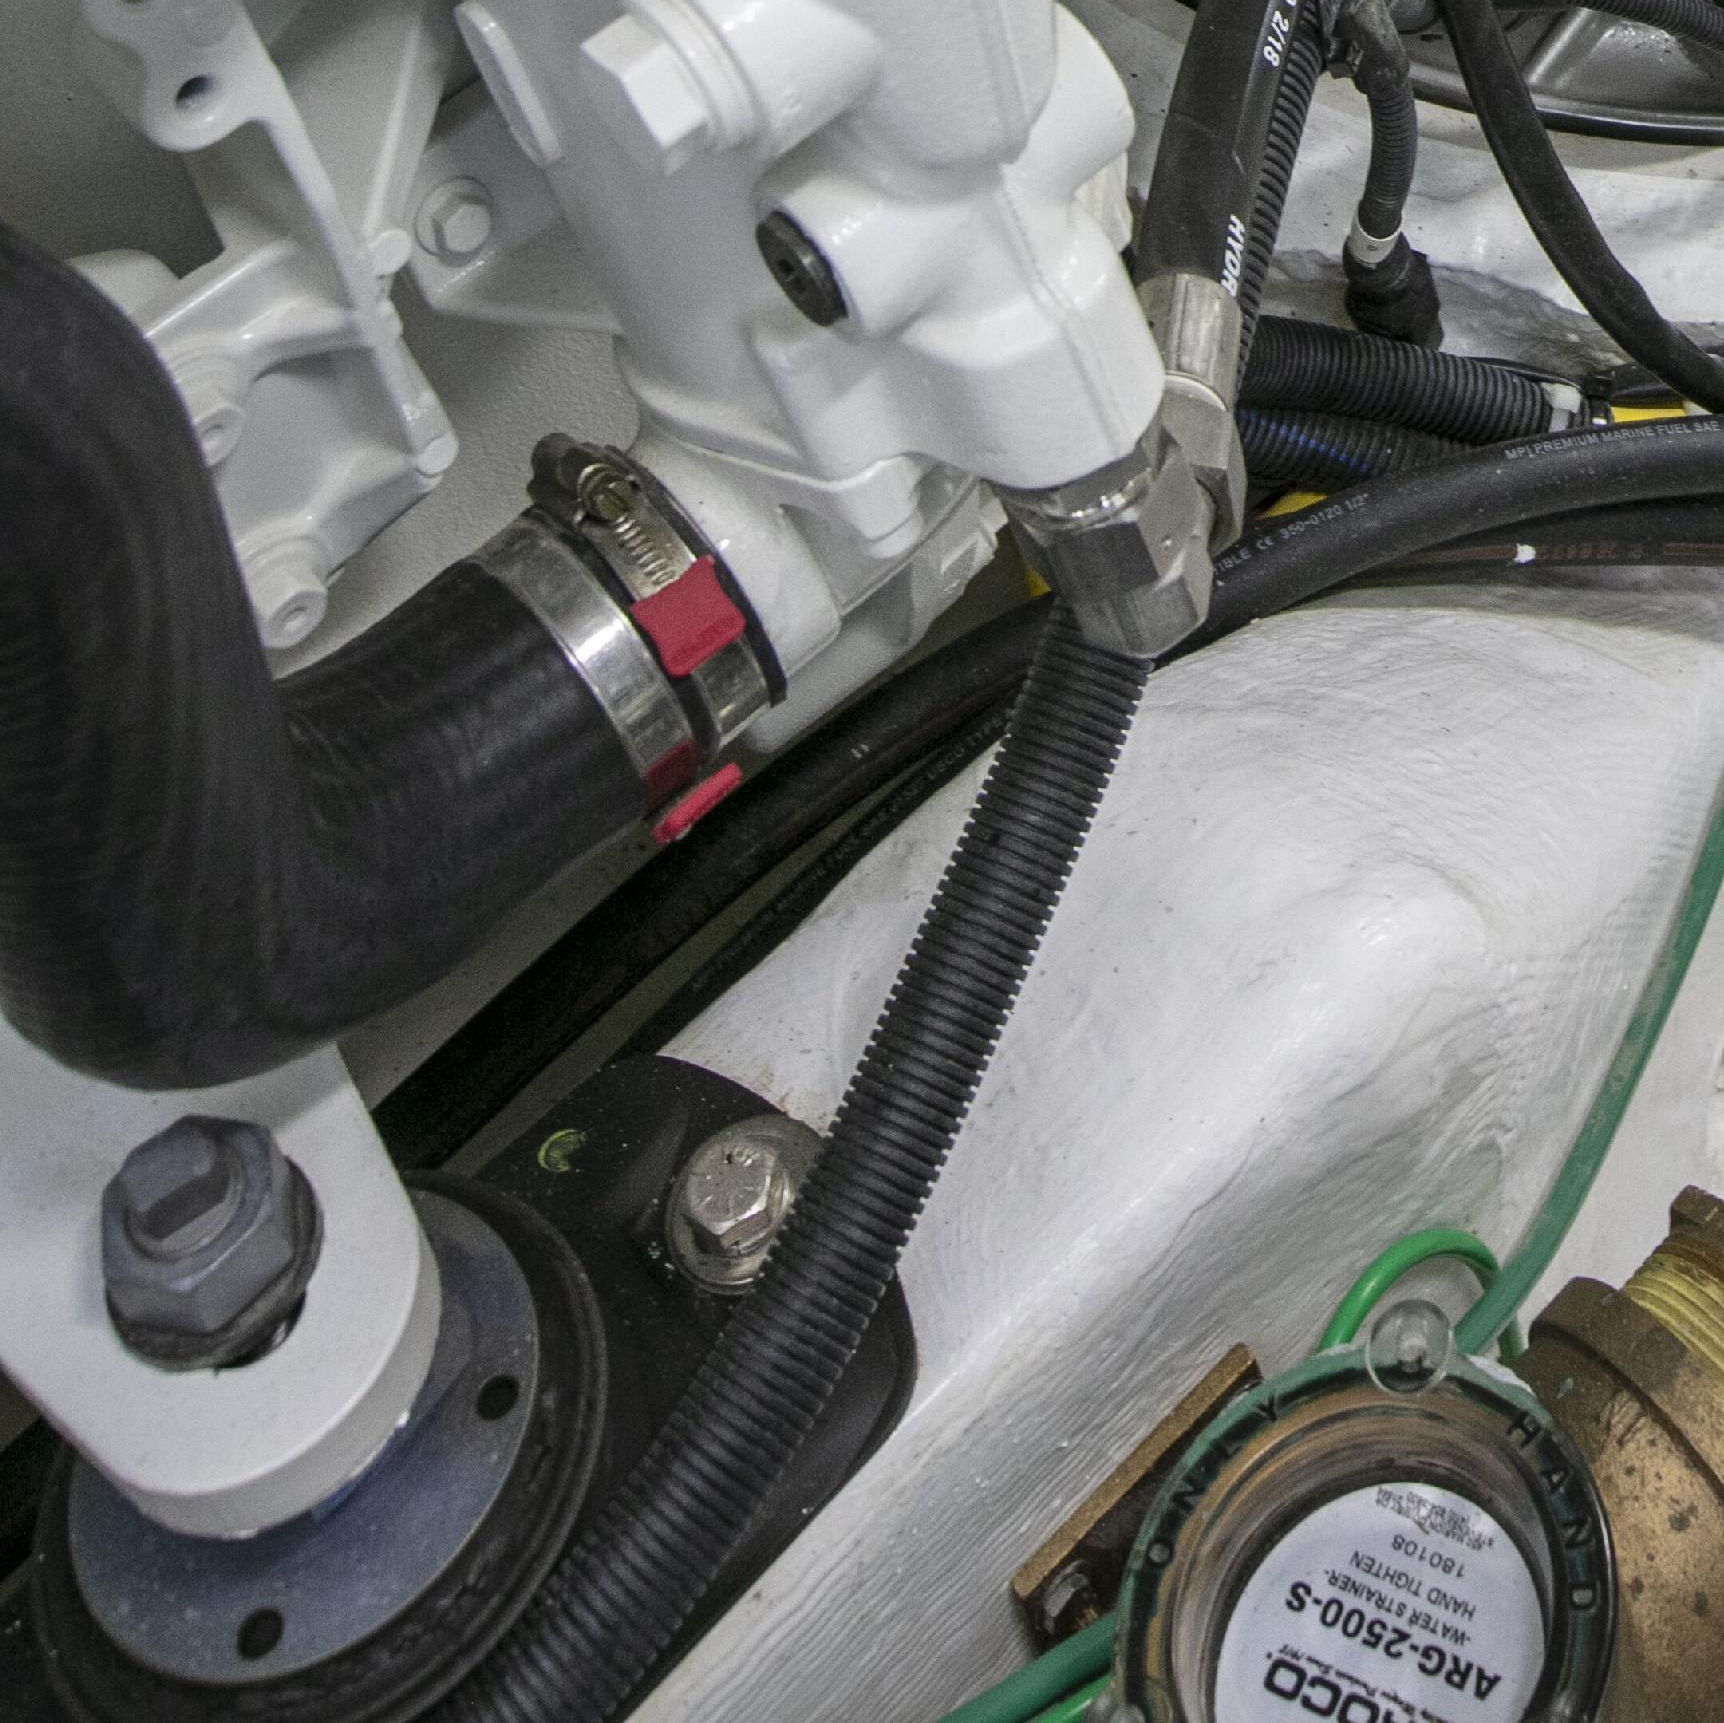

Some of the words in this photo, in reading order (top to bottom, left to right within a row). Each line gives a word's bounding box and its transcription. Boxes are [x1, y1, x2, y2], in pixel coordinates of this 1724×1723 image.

[1263, 10, 1289, 67] 2/18
[1534, 432, 1600, 458] PREMIUM
[1600, 425, 1653, 443] MARINE
[1656, 423, 1692, 436] FUEL
[1694, 419, 1721, 433] SAE
[1147, 1395, 1280, 1567] ONLY
[1502, 1409, 1597, 1612] HAND
[1349, 1550, 1424, 1598] TIGHTEN
[1391, 1534, 1466, 1579] 180108
[1323, 1568, 1408, 1618] STRAINER-
[1427, 1586, 1477, 1621] HAND
[1284, 1580, 1502, 1701] ARG-2500-S
[1409, 1608, 1472, 1647] -WATER
[1263, 1656, 1396, 1723] OCO
